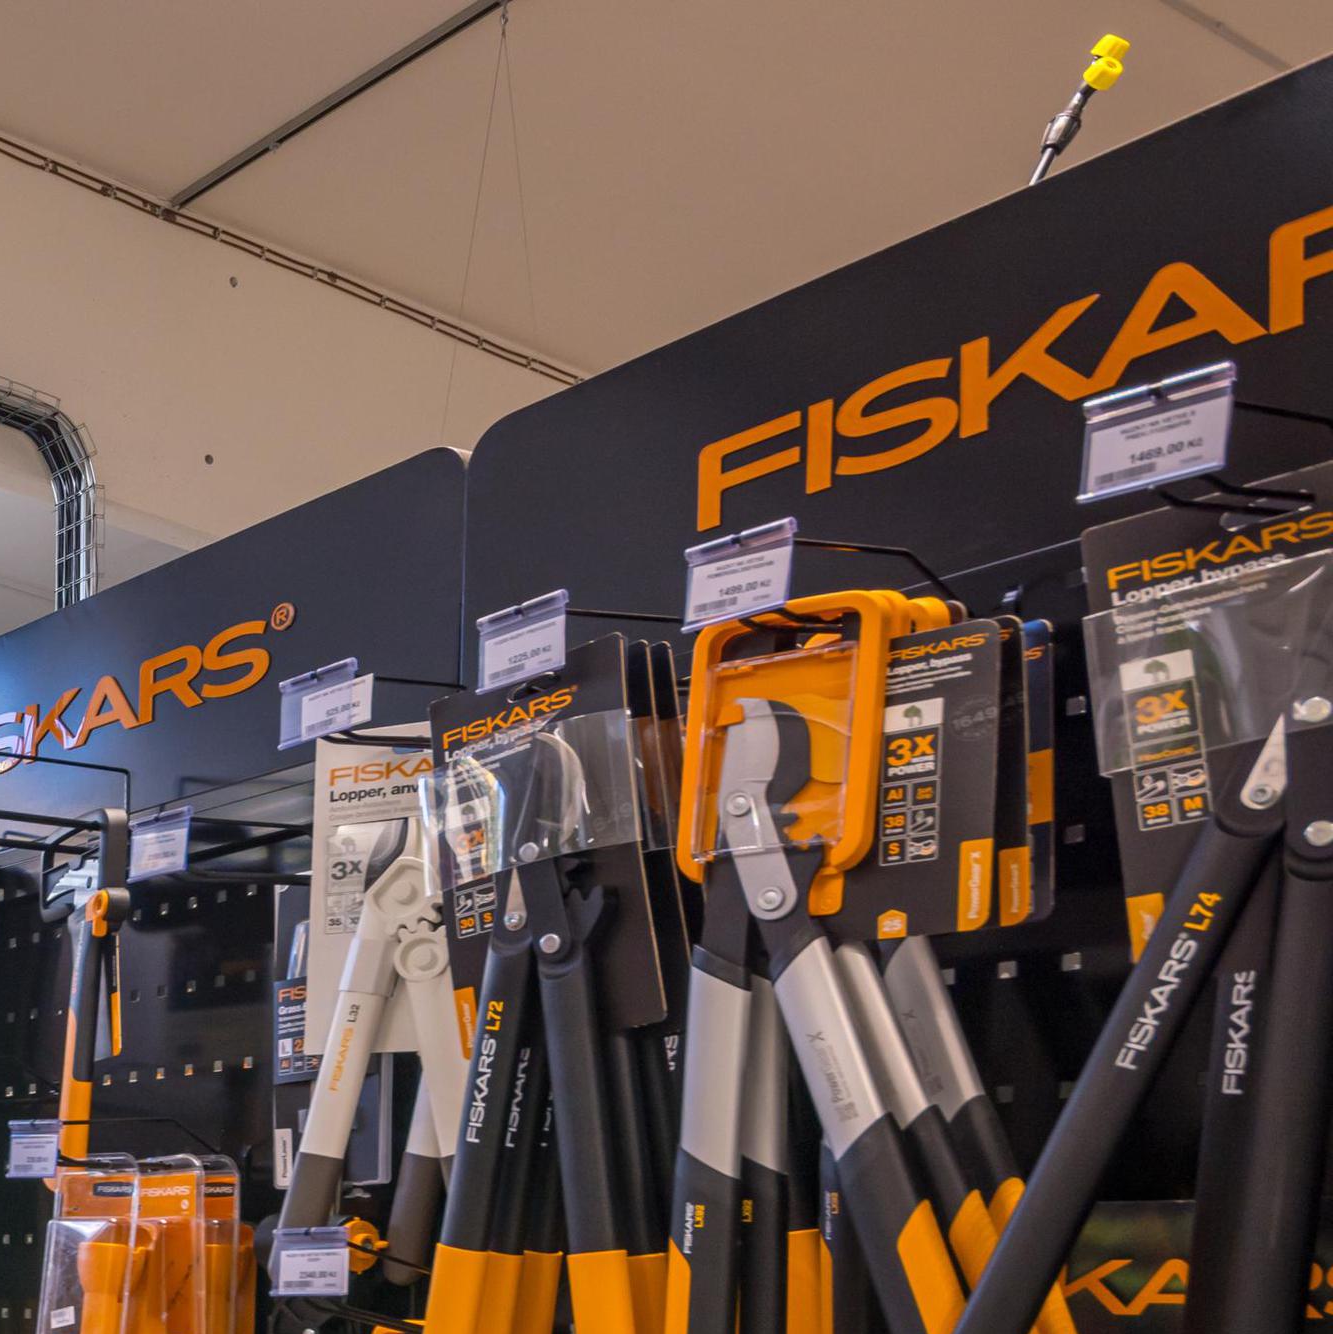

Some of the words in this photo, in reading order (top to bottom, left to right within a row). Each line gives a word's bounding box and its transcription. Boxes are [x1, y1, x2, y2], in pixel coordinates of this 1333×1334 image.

[1107, 511, 1333, 590] FISKARS
[890, 633, 988, 661] FISKARS
[442, 689, 573, 750] FISKARS
[887, 734, 935, 766] 3X
[888, 761, 935, 777] POWER
[330, 787, 387, 803] Lopper,
[331, 859, 363, 880] 3X
[1183, 892, 1223, 933] L74
[347, 1003, 361, 1023] L32
[487, 1001, 504, 1032] L72
[1116, 936, 1195, 1072] FISKARS
[329, 1027, 354, 1092] FISKARS
[466, 1037, 497, 1143] FISKARS
